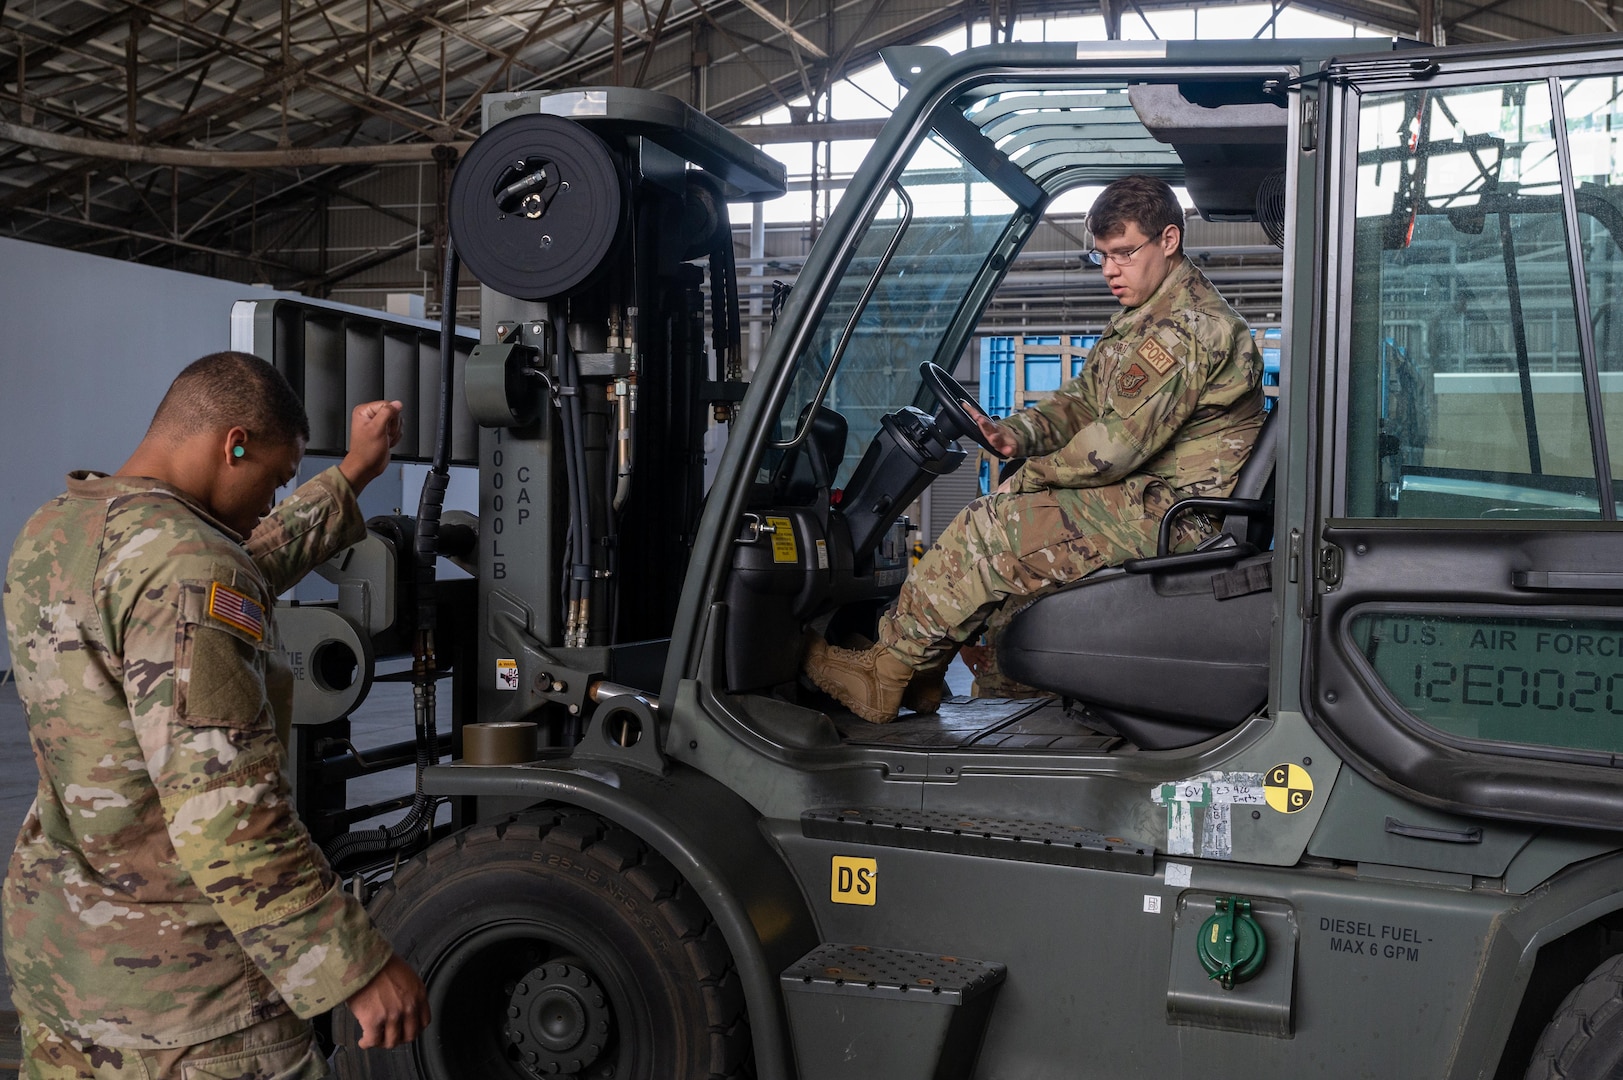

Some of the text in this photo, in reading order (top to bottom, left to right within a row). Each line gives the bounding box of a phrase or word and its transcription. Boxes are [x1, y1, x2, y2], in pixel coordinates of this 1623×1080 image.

[1141, 341, 1172, 369] PORT
[517, 466, 531, 525] CAP
[1393, 623, 1444, 646] U.S.
[1469, 628, 1518, 651] AIR
[287, 651, 303, 666] IE
[1273, 769, 1304, 806] C G
[838, 866, 871, 895] DS
[1320, 917, 1376, 938] DIESEL
[1382, 925, 1423, 944] FUEL
[1330, 937, 1419, 962] MAX 6 GPM
